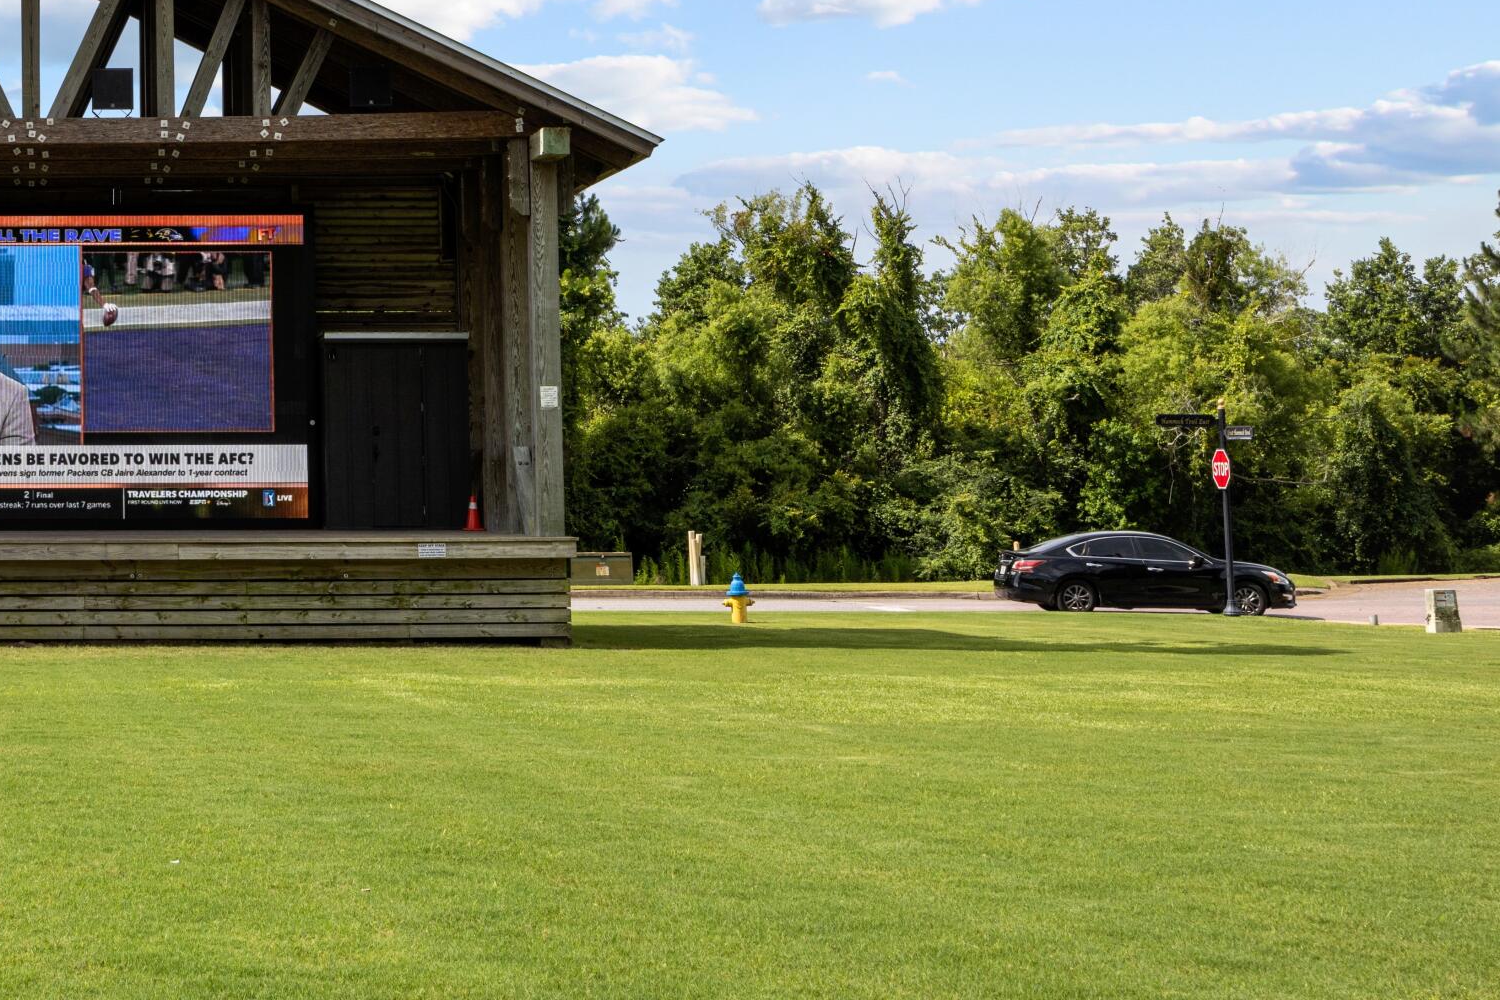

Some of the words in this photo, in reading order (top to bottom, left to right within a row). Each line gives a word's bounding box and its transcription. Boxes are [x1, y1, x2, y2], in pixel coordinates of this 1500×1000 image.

[19, 229, 60, 242] THE
[64, 229, 122, 242] RAVE
[26, 453, 45, 466] BE
[50, 453, 119, 466] FAVORED
[124, 453, 144, 466] TO
[149, 453, 180, 466] WIN
[184, 453, 214, 466] THE
[218, 453, 254, 466] AFC?
[19, 469, 37, 479] sign
[38, 469, 65, 477] former
[67, 469, 99, 477] Packers
[100, 469, 113, 477] CB
[114, 469, 134, 477] Jaire
[136, 469, 176, 477] Alexander
[178, 469, 186, 477] to
[189, 469, 213, 478] 1-year
[214, 469, 248, 477] contract
[1213, 462, 1229, 477] STOP
[23, 491, 30, 499] 2
[36, 491, 54, 499] Final
[127, 490, 177, 498] TRAVELERS
[178, 490, 248, 498] CHAMPIONSHIP
[86, 502, 111, 510] games
